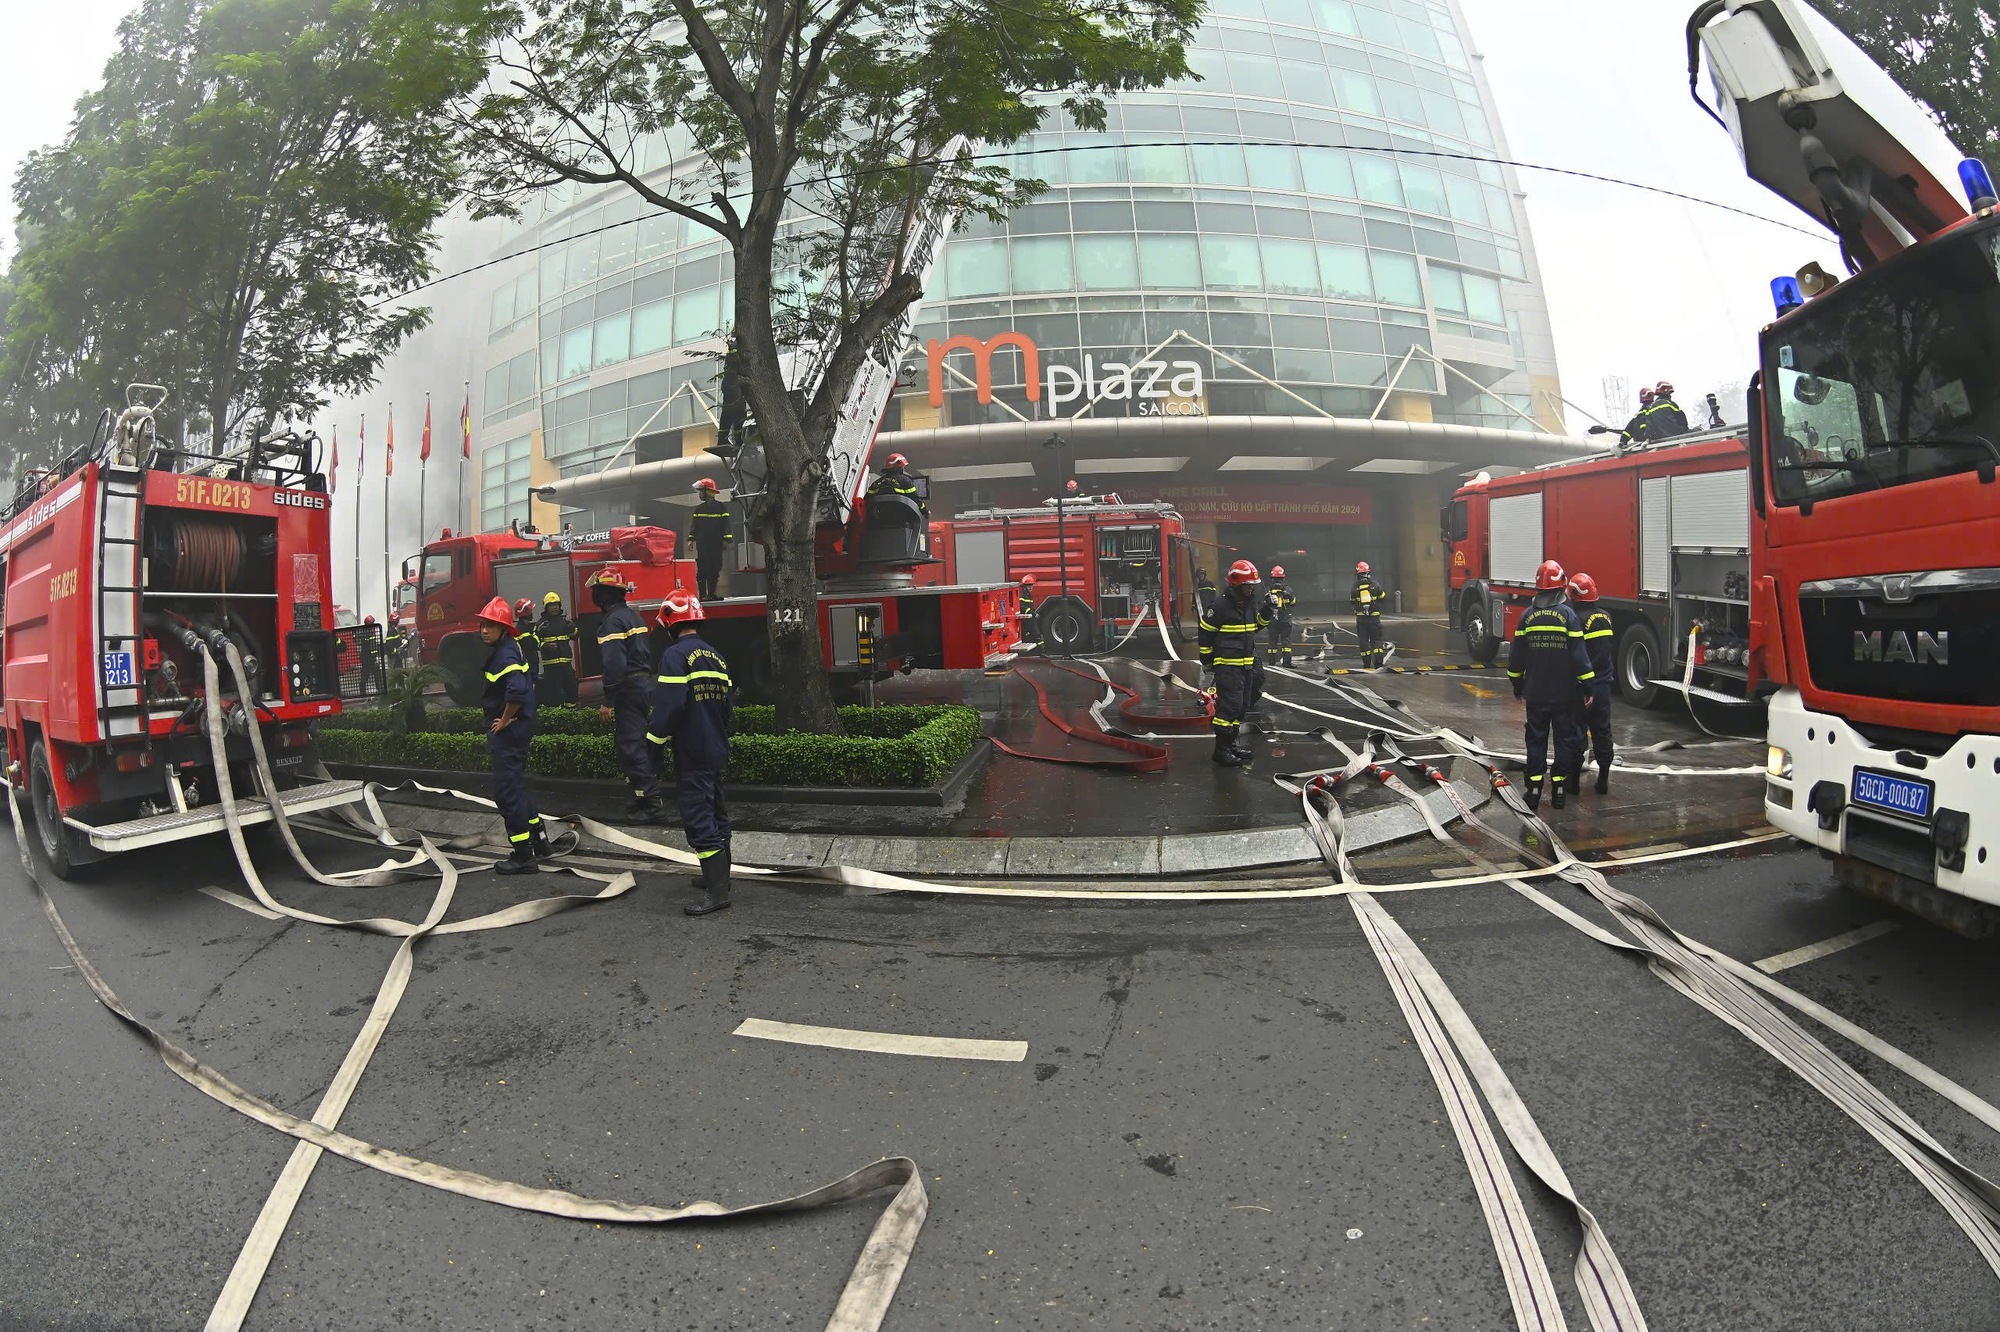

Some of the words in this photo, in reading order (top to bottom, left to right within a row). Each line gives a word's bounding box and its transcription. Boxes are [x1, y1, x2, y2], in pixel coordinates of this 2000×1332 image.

[1139, 402, 1205, 416] SAIGON
[177, 479, 250, 510] 51F.0213
[273, 490, 325, 509] sides
[1160, 487, 1189, 497] FIRE
[1191, 487, 1229, 497] DRILL
[1241, 501, 1253, 513] HỘ
[1273, 501, 1300, 513] THÀNH
[1302, 501, 1319, 513] PHỐ
[1340, 505, 1361, 514] 2024
[26, 500, 57, 531] sides
[585, 531, 610, 542] COFFEE
[50, 568, 78, 603] 51F.0213
[774, 608, 801, 623] 121
[1853, 630, 1949, 665] MAN
[105, 654, 124, 669] 51F
